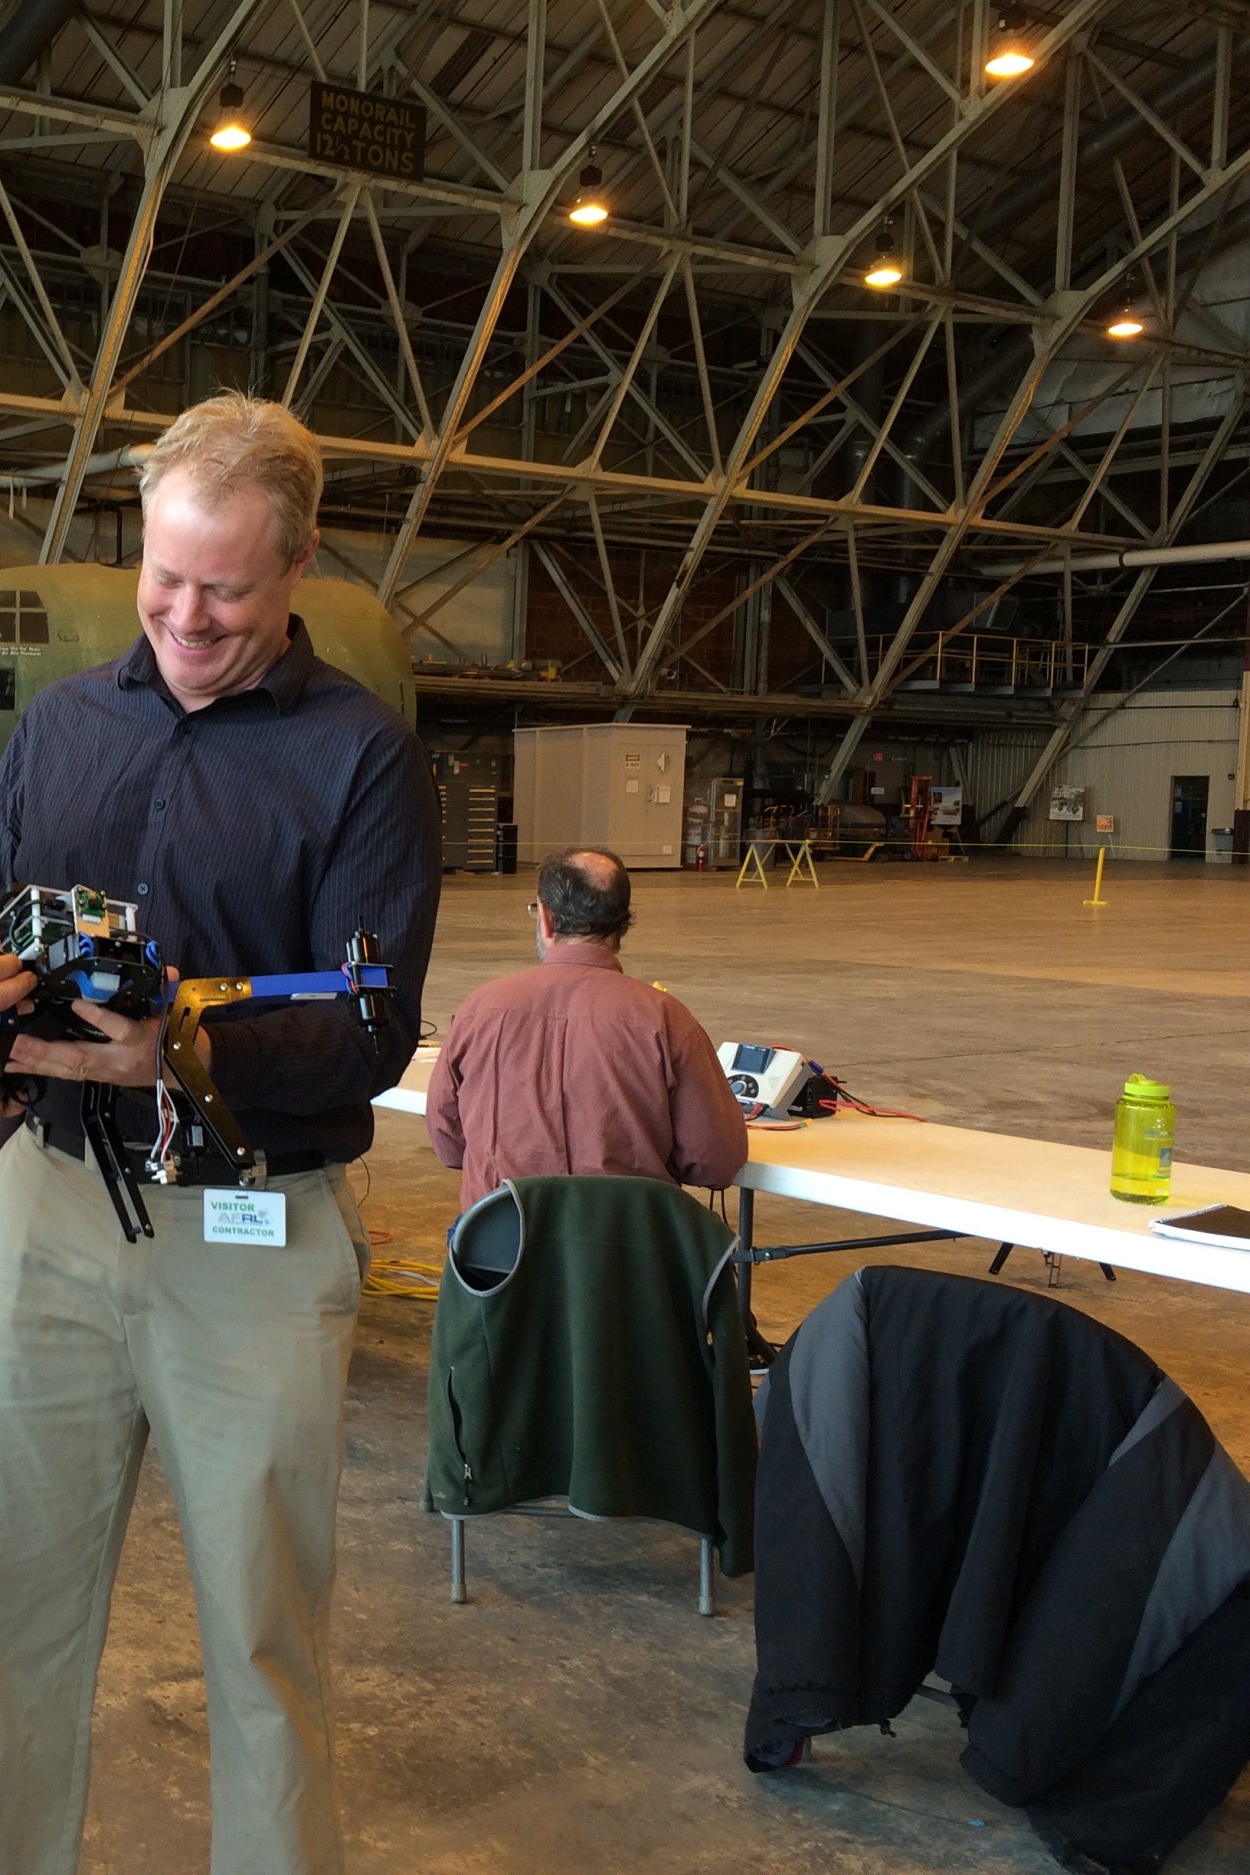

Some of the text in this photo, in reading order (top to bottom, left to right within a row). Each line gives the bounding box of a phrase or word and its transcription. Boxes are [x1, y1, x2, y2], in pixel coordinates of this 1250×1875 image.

[322, 91, 415, 128] MONORAIL
[321, 113, 415, 148] CAPACITY
[352, 141, 414, 173] TONS
[211, 1201, 255, 1212] VISITOR
[212, 1226, 274, 1237] CONTRACTOR
